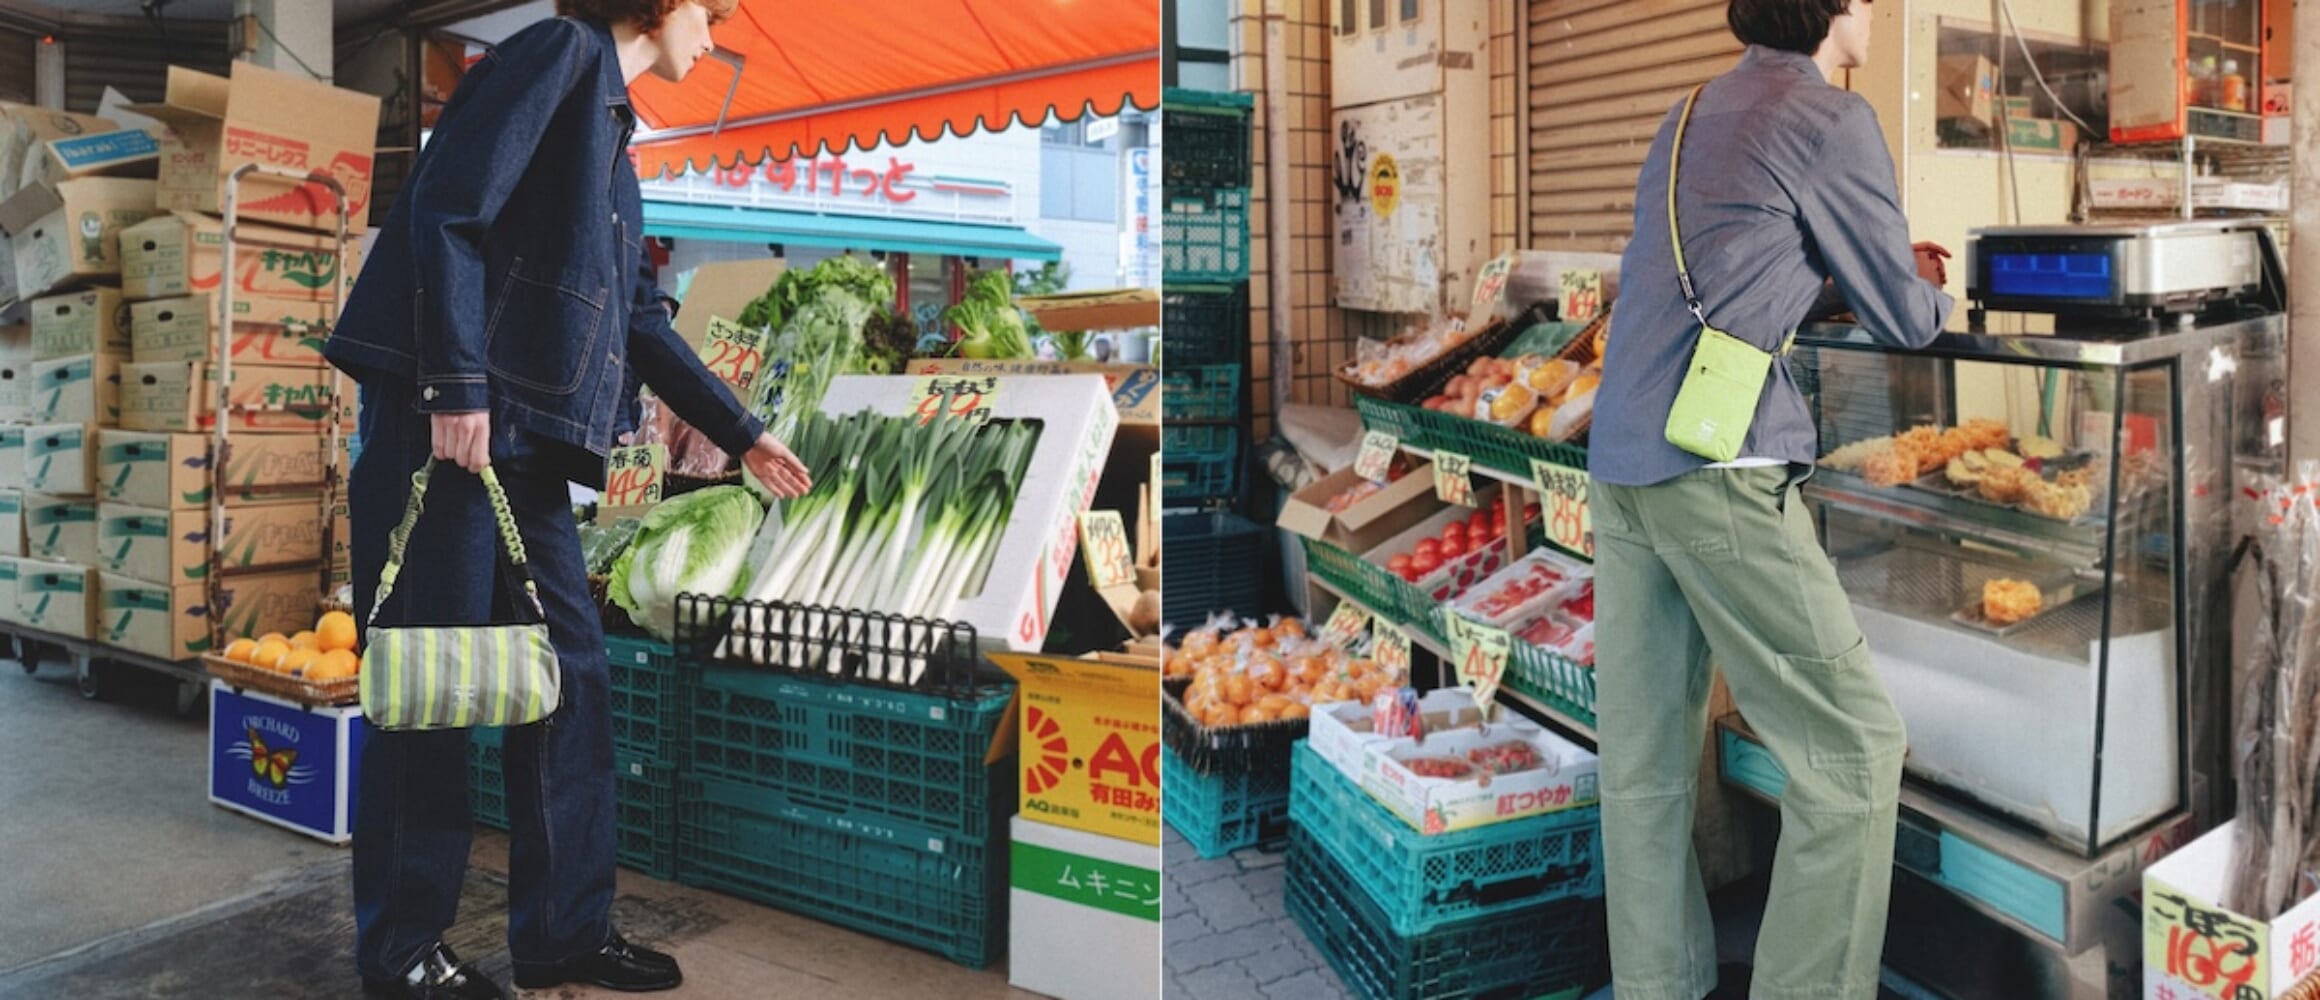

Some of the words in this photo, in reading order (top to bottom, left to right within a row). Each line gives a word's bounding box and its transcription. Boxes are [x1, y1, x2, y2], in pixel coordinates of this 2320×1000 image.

[242, 715, 300, 743] ORCHARD
[247, 778, 292, 805] BREEZE
[1089, 783, 1160, 813] 有田み
[1496, 784, 1571, 817] 紅つやか
